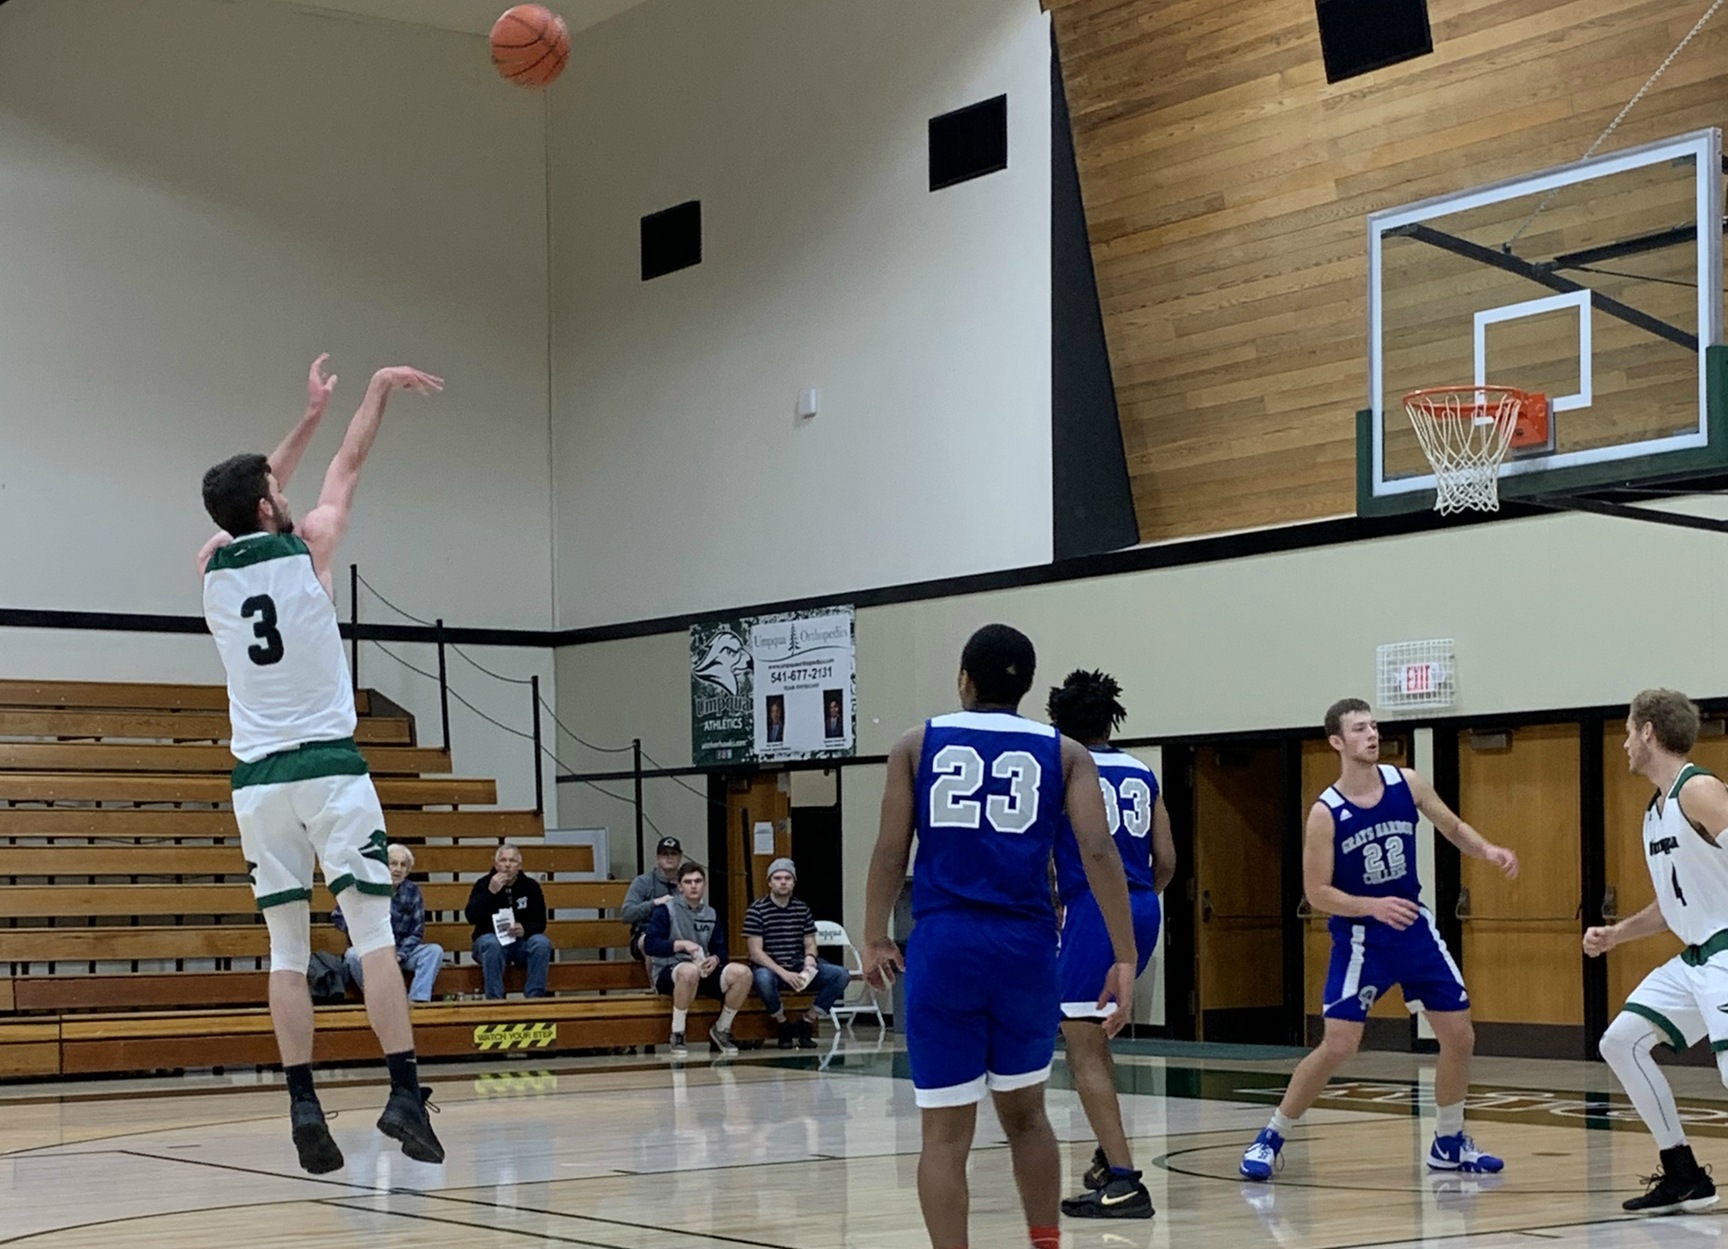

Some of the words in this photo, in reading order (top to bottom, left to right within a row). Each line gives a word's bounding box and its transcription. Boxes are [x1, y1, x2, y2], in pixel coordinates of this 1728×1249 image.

[240, 594, 285, 666] 3
[770, 666, 832, 684] 541-677-2131
[1406, 665, 1430, 692] EXIT
[703, 717, 743, 732] ATHLETICS
[929, 744, 1041, 834] 23
[1362, 835, 1406, 873] 22
[477, 1032, 507, 1041] WATCH
[508, 1031, 532, 1040] YOUR
[532, 1029, 553, 1039] STEP
